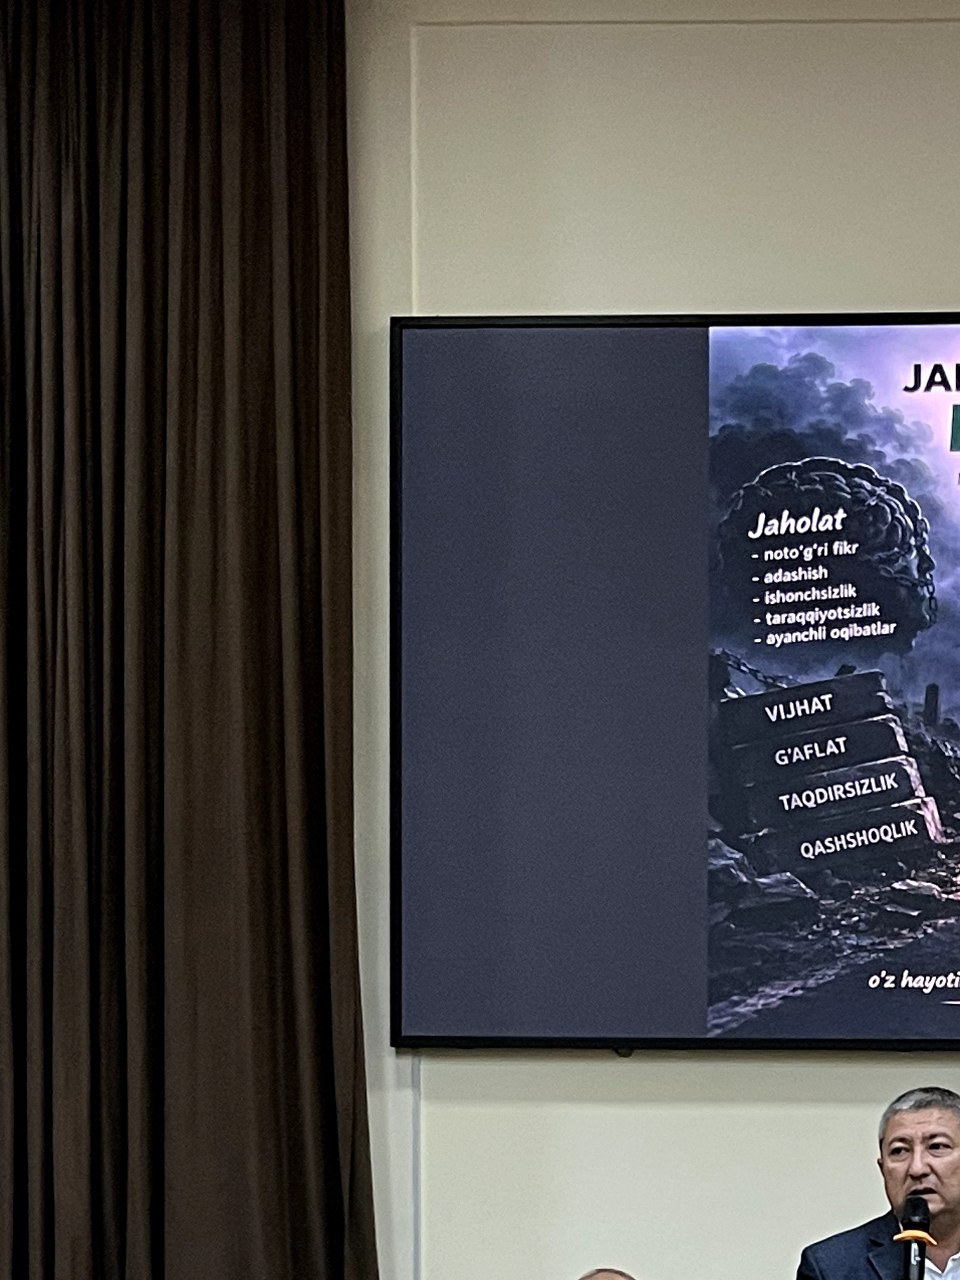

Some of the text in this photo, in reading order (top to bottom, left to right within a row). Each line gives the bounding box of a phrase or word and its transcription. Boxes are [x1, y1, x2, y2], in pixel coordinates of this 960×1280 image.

[747, 507, 847, 539] Jaholat
[764, 543, 828, 562] noto'g'ri
[832, 541, 859, 556] fikr
[764, 565, 828, 584] adashish
[764, 584, 857, 604] ishonchsizlik
[765, 602, 880, 626] taraqqiyotsizlik
[766, 626, 827, 647] ayanchli
[830, 622, 896, 640] oqibatlar
[765, 694, 833, 722] VIJHAT
[775, 737, 847, 765] G'AFLAT
[779, 773, 898, 811] TAQDIRSIZLIK
[800, 820, 918, 860] QASHSHOQLIK
[868, 970, 895, 988] o'z
